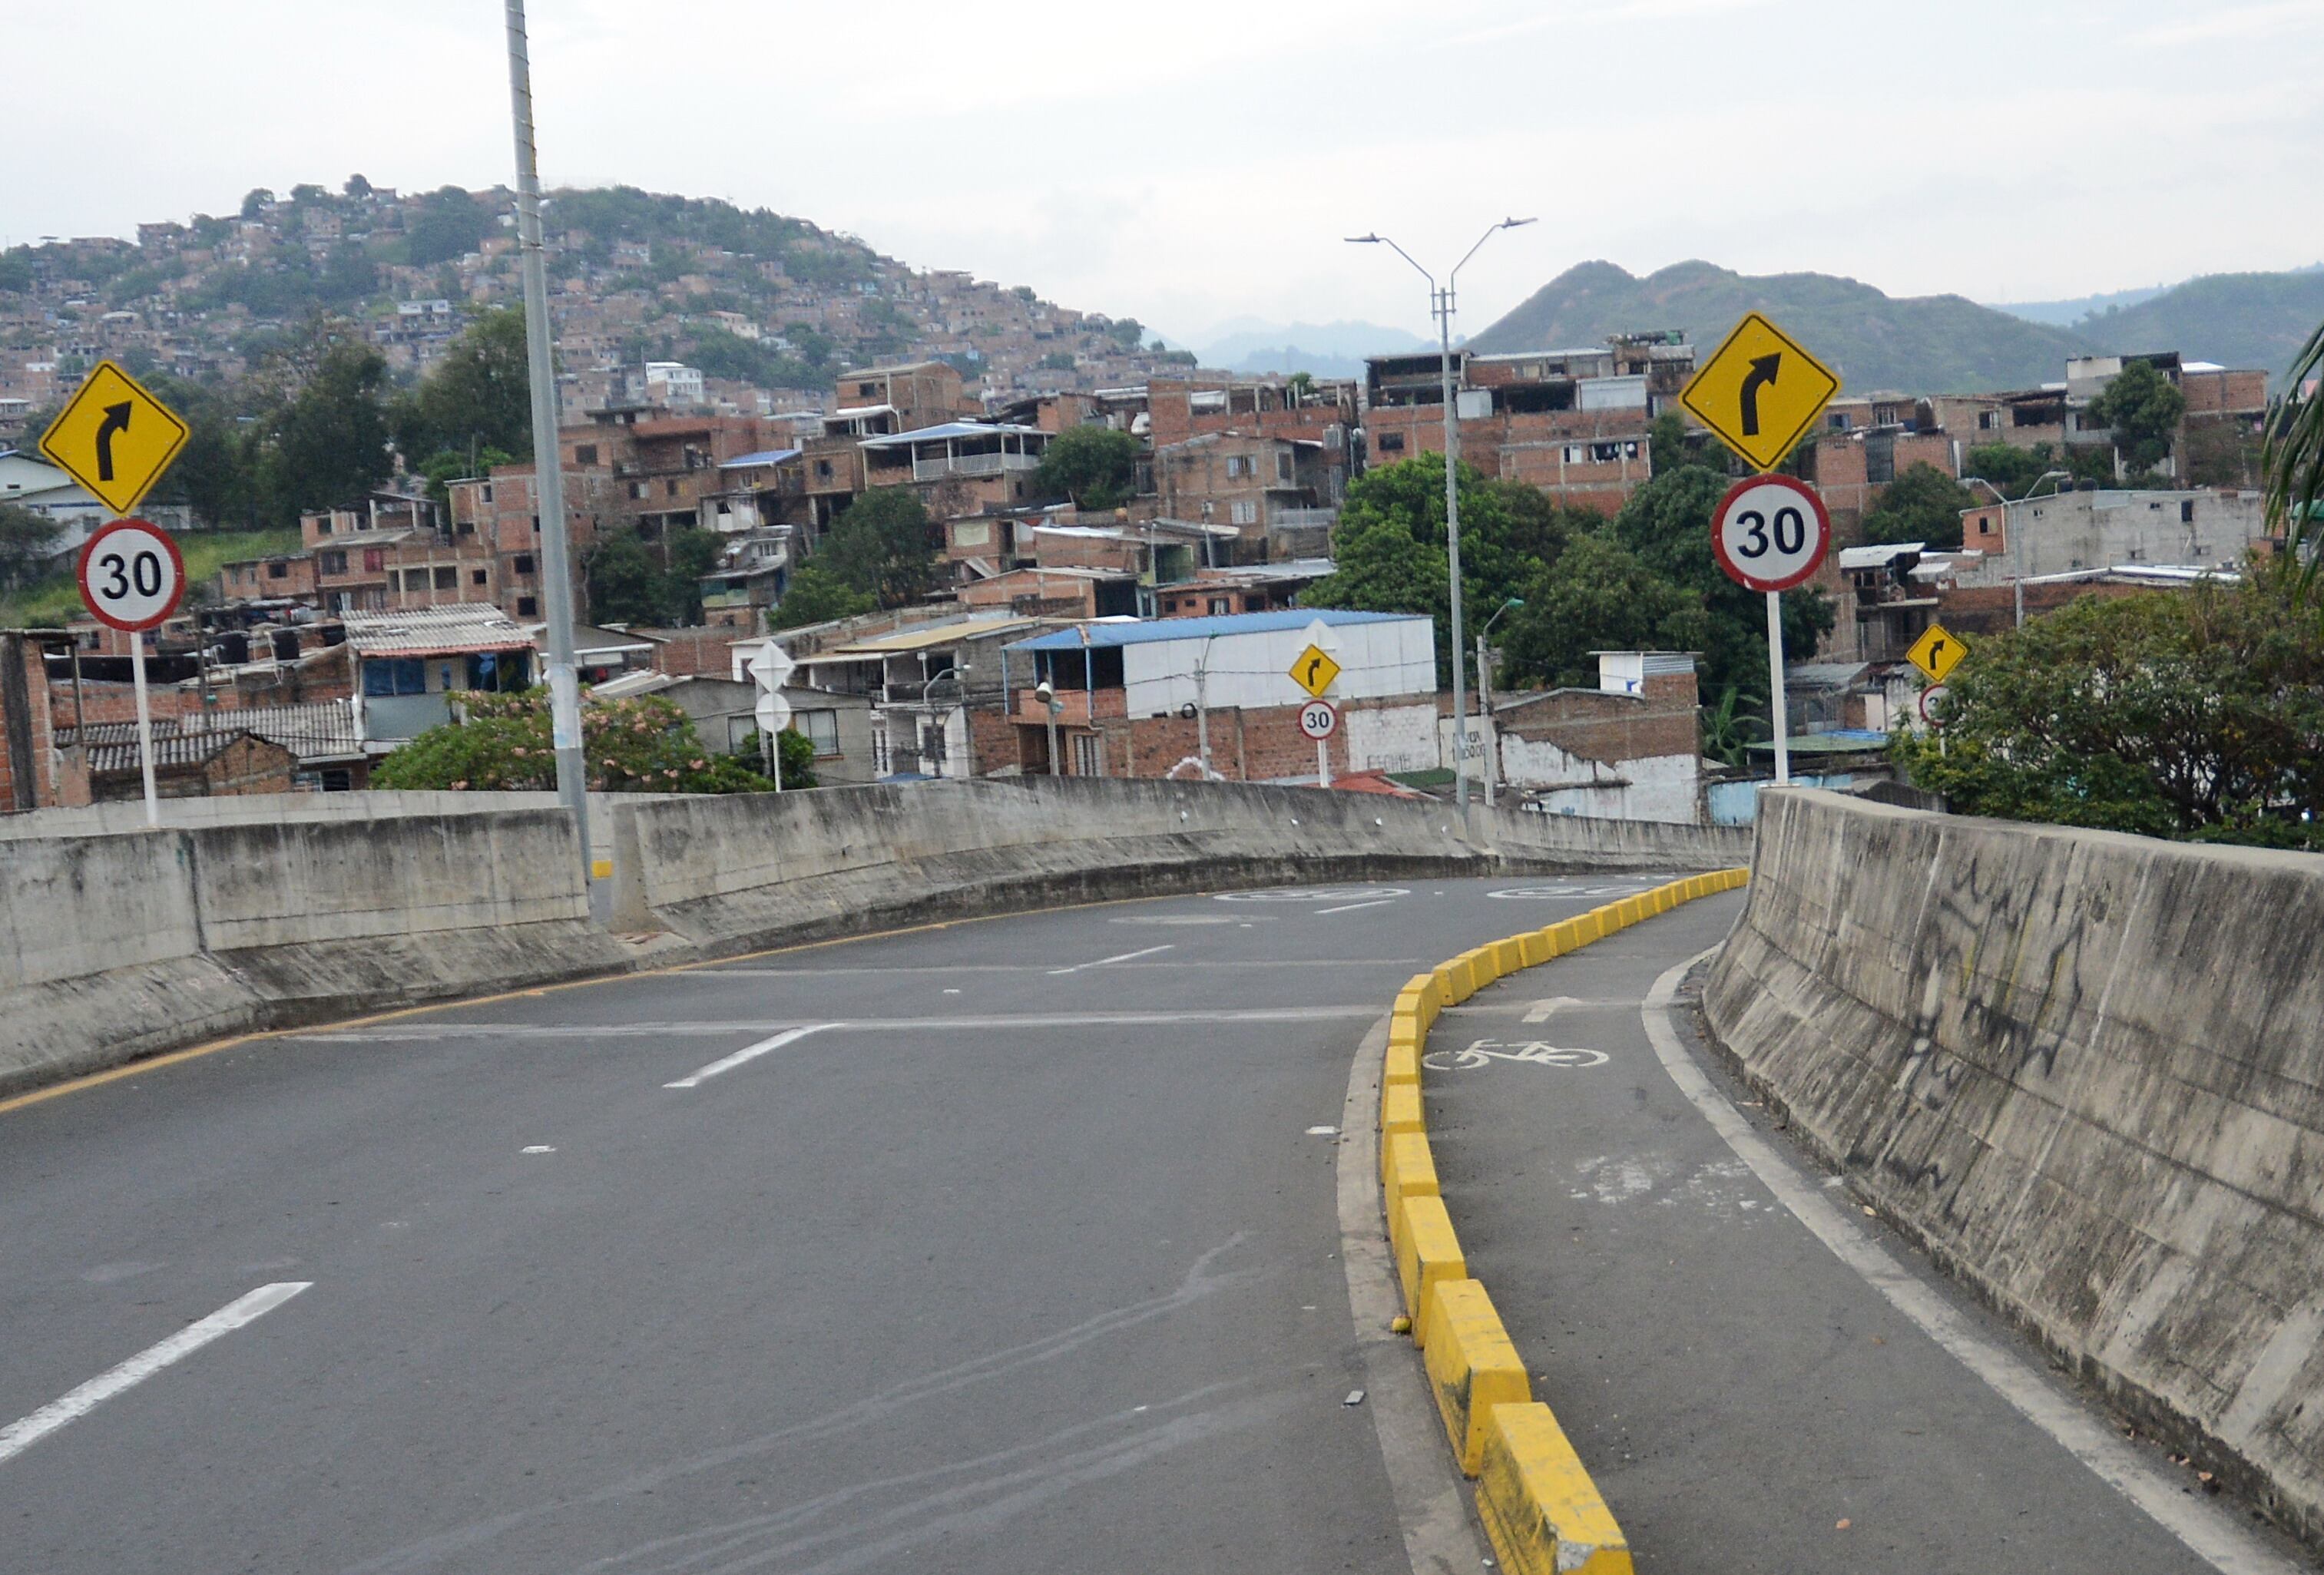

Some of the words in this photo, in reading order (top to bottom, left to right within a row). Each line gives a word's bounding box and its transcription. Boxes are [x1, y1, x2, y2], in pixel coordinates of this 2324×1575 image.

[1736, 506, 1805, 558] 30
[100, 550, 161, 600] 30
[1306, 711, 1329, 729] 30
